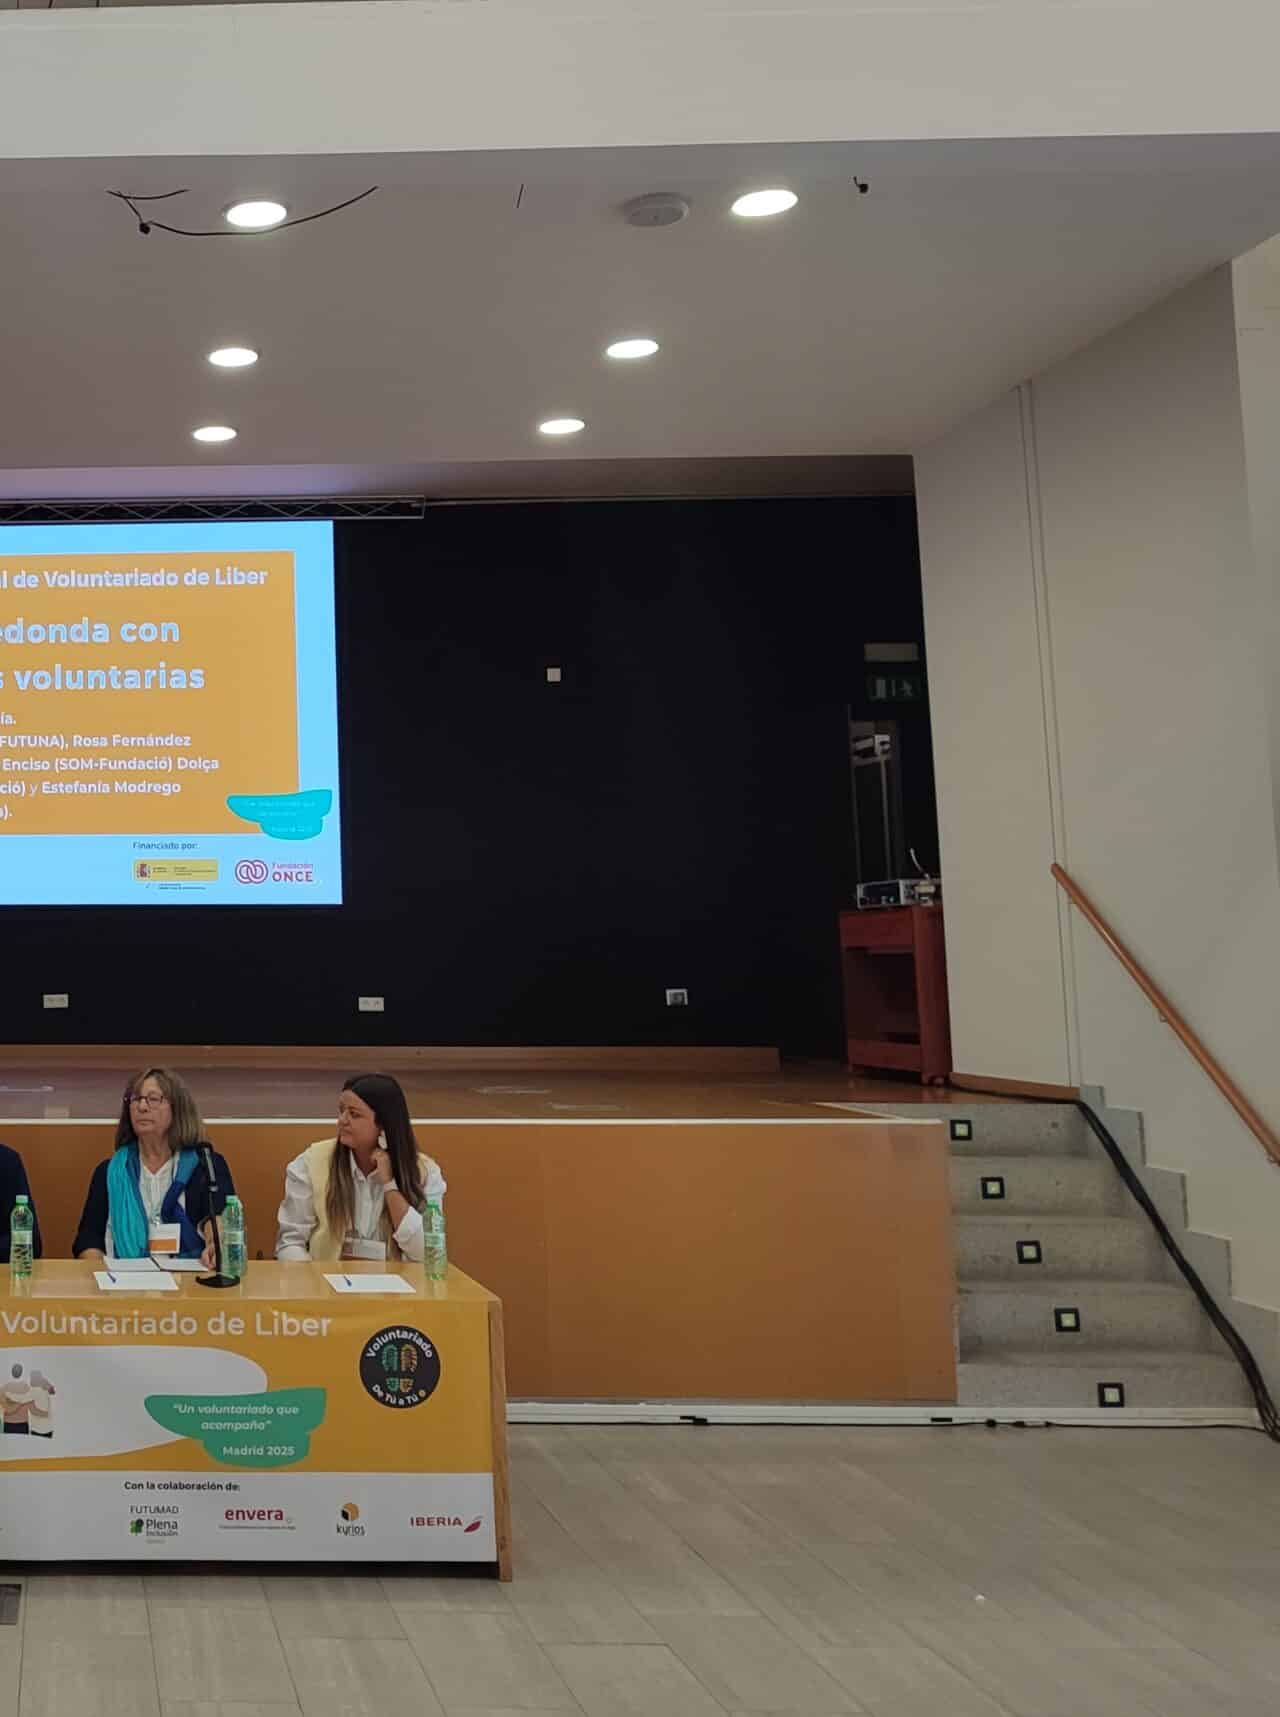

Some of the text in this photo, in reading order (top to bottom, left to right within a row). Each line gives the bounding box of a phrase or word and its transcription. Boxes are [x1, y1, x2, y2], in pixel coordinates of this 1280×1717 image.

[13, 571, 39, 588] de
[44, 568, 179, 588] Voluntariado
[184, 568, 209, 586] de
[215, 566, 268, 585] Liber
[120, 621, 180, 643] con
[15, 661, 206, 690] voluntarias
[72, 735, 108, 747] Rosa
[112, 733, 192, 747] Fernández
[3, 758, 50, 771] Enciso
[55, 757, 172, 773] (SOM-Fundació)
[177, 757, 219, 773] Dolça
[30, 783, 38, 797] y
[115, 781, 181, 795] Modrego
[133, 841, 179, 850] Financiado
[272, 871, 313, 883] ONCE
[1, 1310, 198, 1336] Voluntariado
[207, 1310, 246, 1336] de
[255, 1310, 332, 1337] Liber
[366, 1329, 433, 1358] Voluntariado
[198, 1404, 274, 1415] voluntariado
[276, 1406, 300, 1415] que
[222, 1445, 295, 1456] Madrid 2025
[124, 1482, 144, 1490] Con
[146, 1482, 156, 1490] la
[157, 1481, 223, 1491] colaboración
[129, 1505, 179, 1514] FUTUMAD
[225, 1508, 284, 1521] envera
[146, 1519, 178, 1530] Plena
[410, 1516, 463, 1527] IBERIA
[336, 1523, 366, 1537] kyrios
